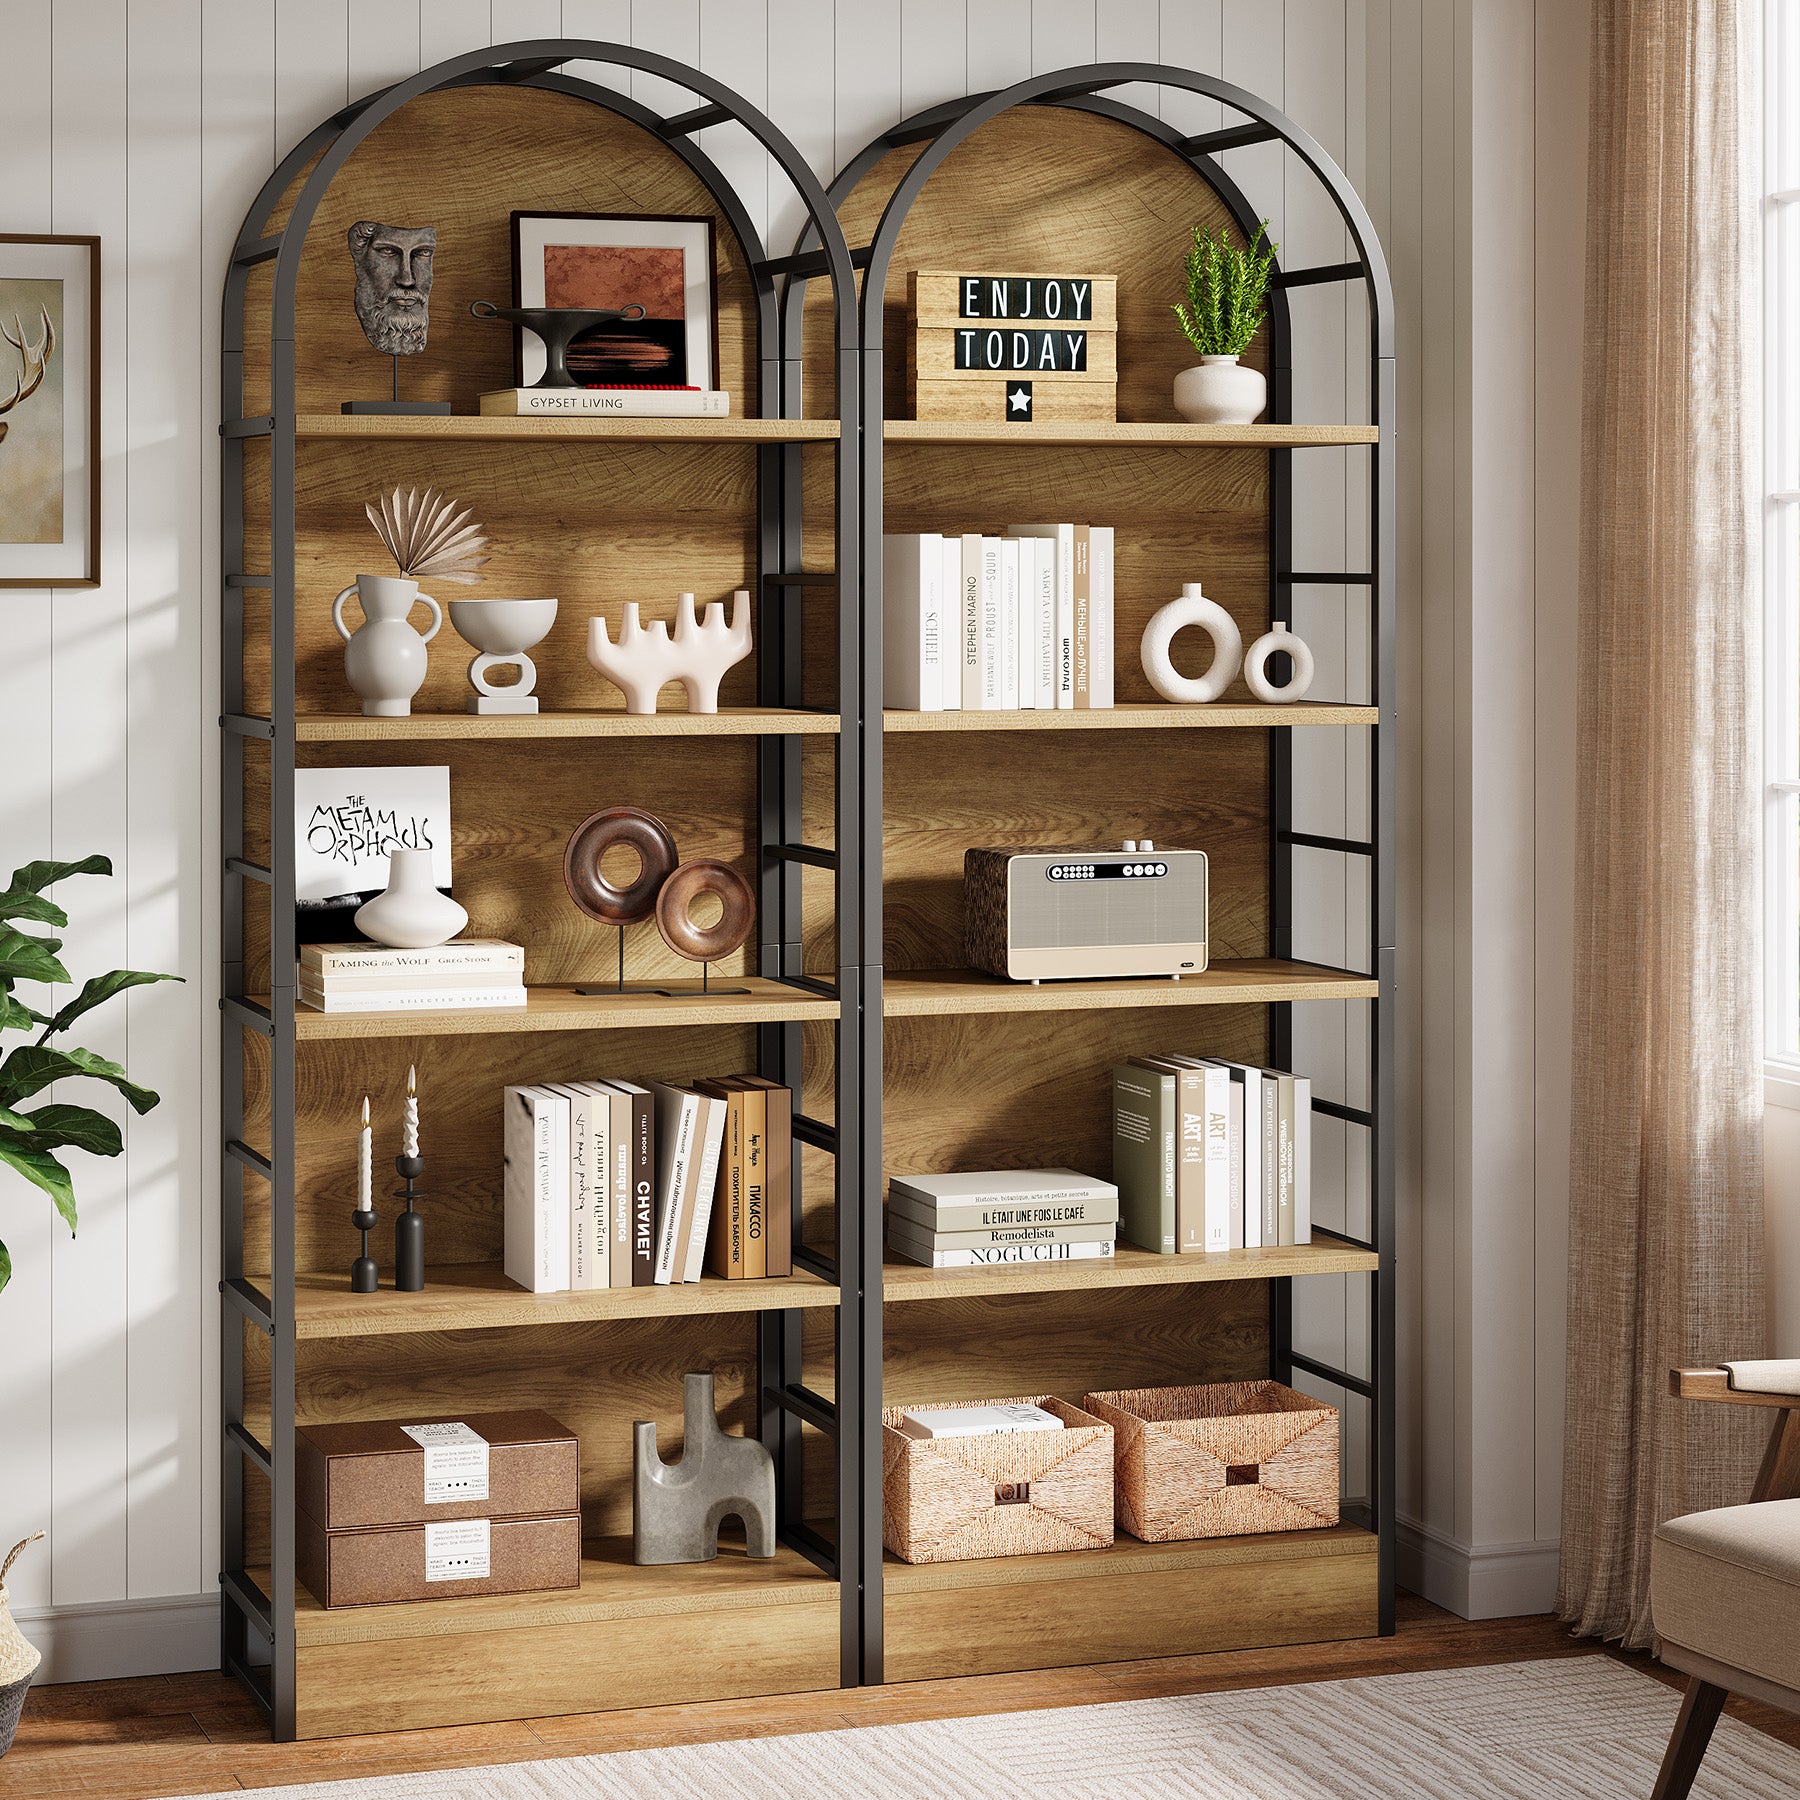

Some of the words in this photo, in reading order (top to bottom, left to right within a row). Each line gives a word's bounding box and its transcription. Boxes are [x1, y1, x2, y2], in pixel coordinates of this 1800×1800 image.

[965, 279, 1088, 320] ENJOY
[959, 330, 1084, 370] TODAY
[530, 397, 577, 409] GYPSET
[581, 398, 623, 409] LIVING
[985, 551, 996, 581] SQUID
[966, 576, 977, 617] MARINO
[1042, 568, 1051, 607] ЗАБОТА
[985, 602, 996, 639] PROUST
[1042, 610, 1051, 619] О
[925, 611, 938, 665] SCHIELE
[966, 619, 977, 666] STEPHEN
[1062, 638, 1070, 691] ШОКОЛАД
[1077, 657, 1087, 693] ЛУЧШЕ
[346, 795, 366, 808] THE
[308, 804, 399, 837] METAM
[381, 958, 394, 967] the
[1183, 1113, 1202, 1142] ART
[1209, 1112, 1226, 1140] ART
[732, 1166, 740, 1223] ПОХИТИТЕЛЬ
[749, 1185, 761, 1239] ПИКАССО
[982, 1212, 990, 1225] IL
[992, 1209, 1015, 1224] ÉTAIT
[1015, 1211, 1032, 1223] UNE
[1033, 1209, 1052, 1222] FOIS
[1052, 1208, 1063, 1220] LE
[1064, 1204, 1085, 1219] CAFÉ
[732, 1224, 740, 1264] БАБОЧЕК
[990, 1228, 1055, 1242] Remodelista
[970, 1243, 1070, 1265] NOGUCHI
